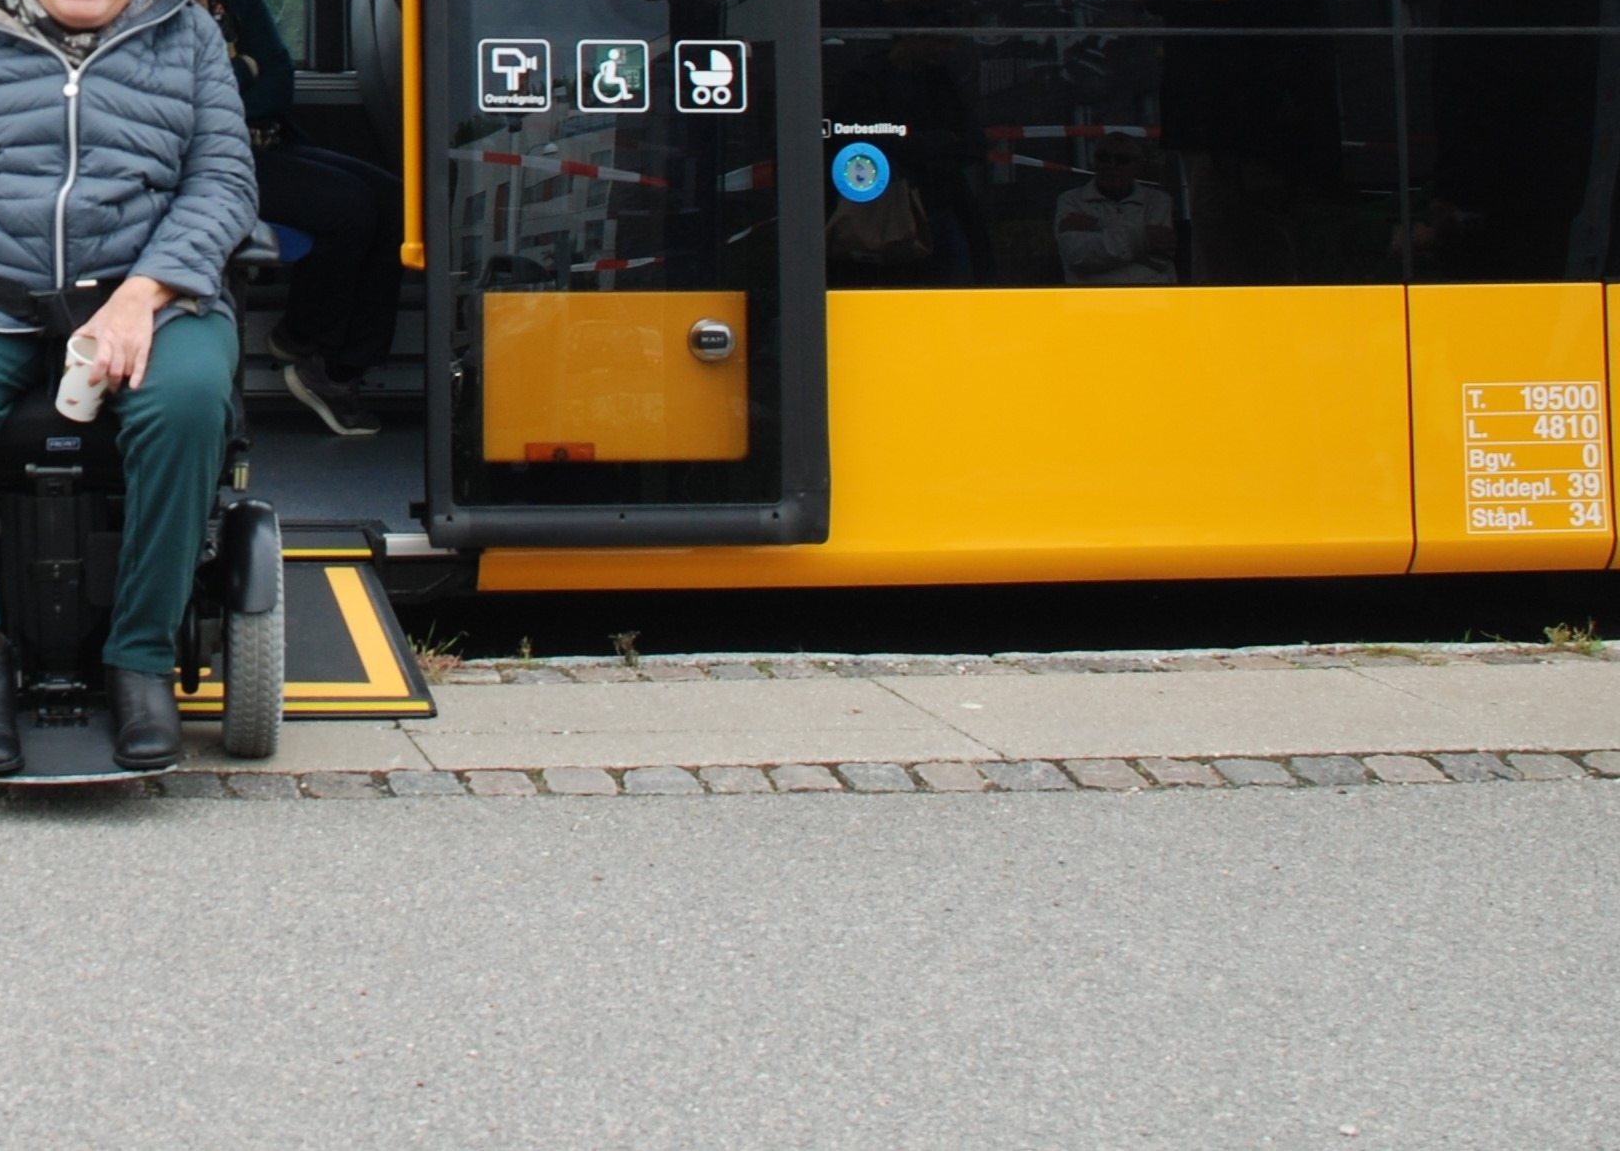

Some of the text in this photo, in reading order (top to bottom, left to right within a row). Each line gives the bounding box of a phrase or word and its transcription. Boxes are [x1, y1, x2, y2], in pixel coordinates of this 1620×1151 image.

[1468, 385, 1598, 410] T. 19500
[1468, 414, 1598, 439] L. 4810
[1469, 442, 1600, 472] Bgv. 0
[1471, 472, 1601, 500] Siddepl. 39
[1472, 501, 1602, 531] Ståpl. 34
